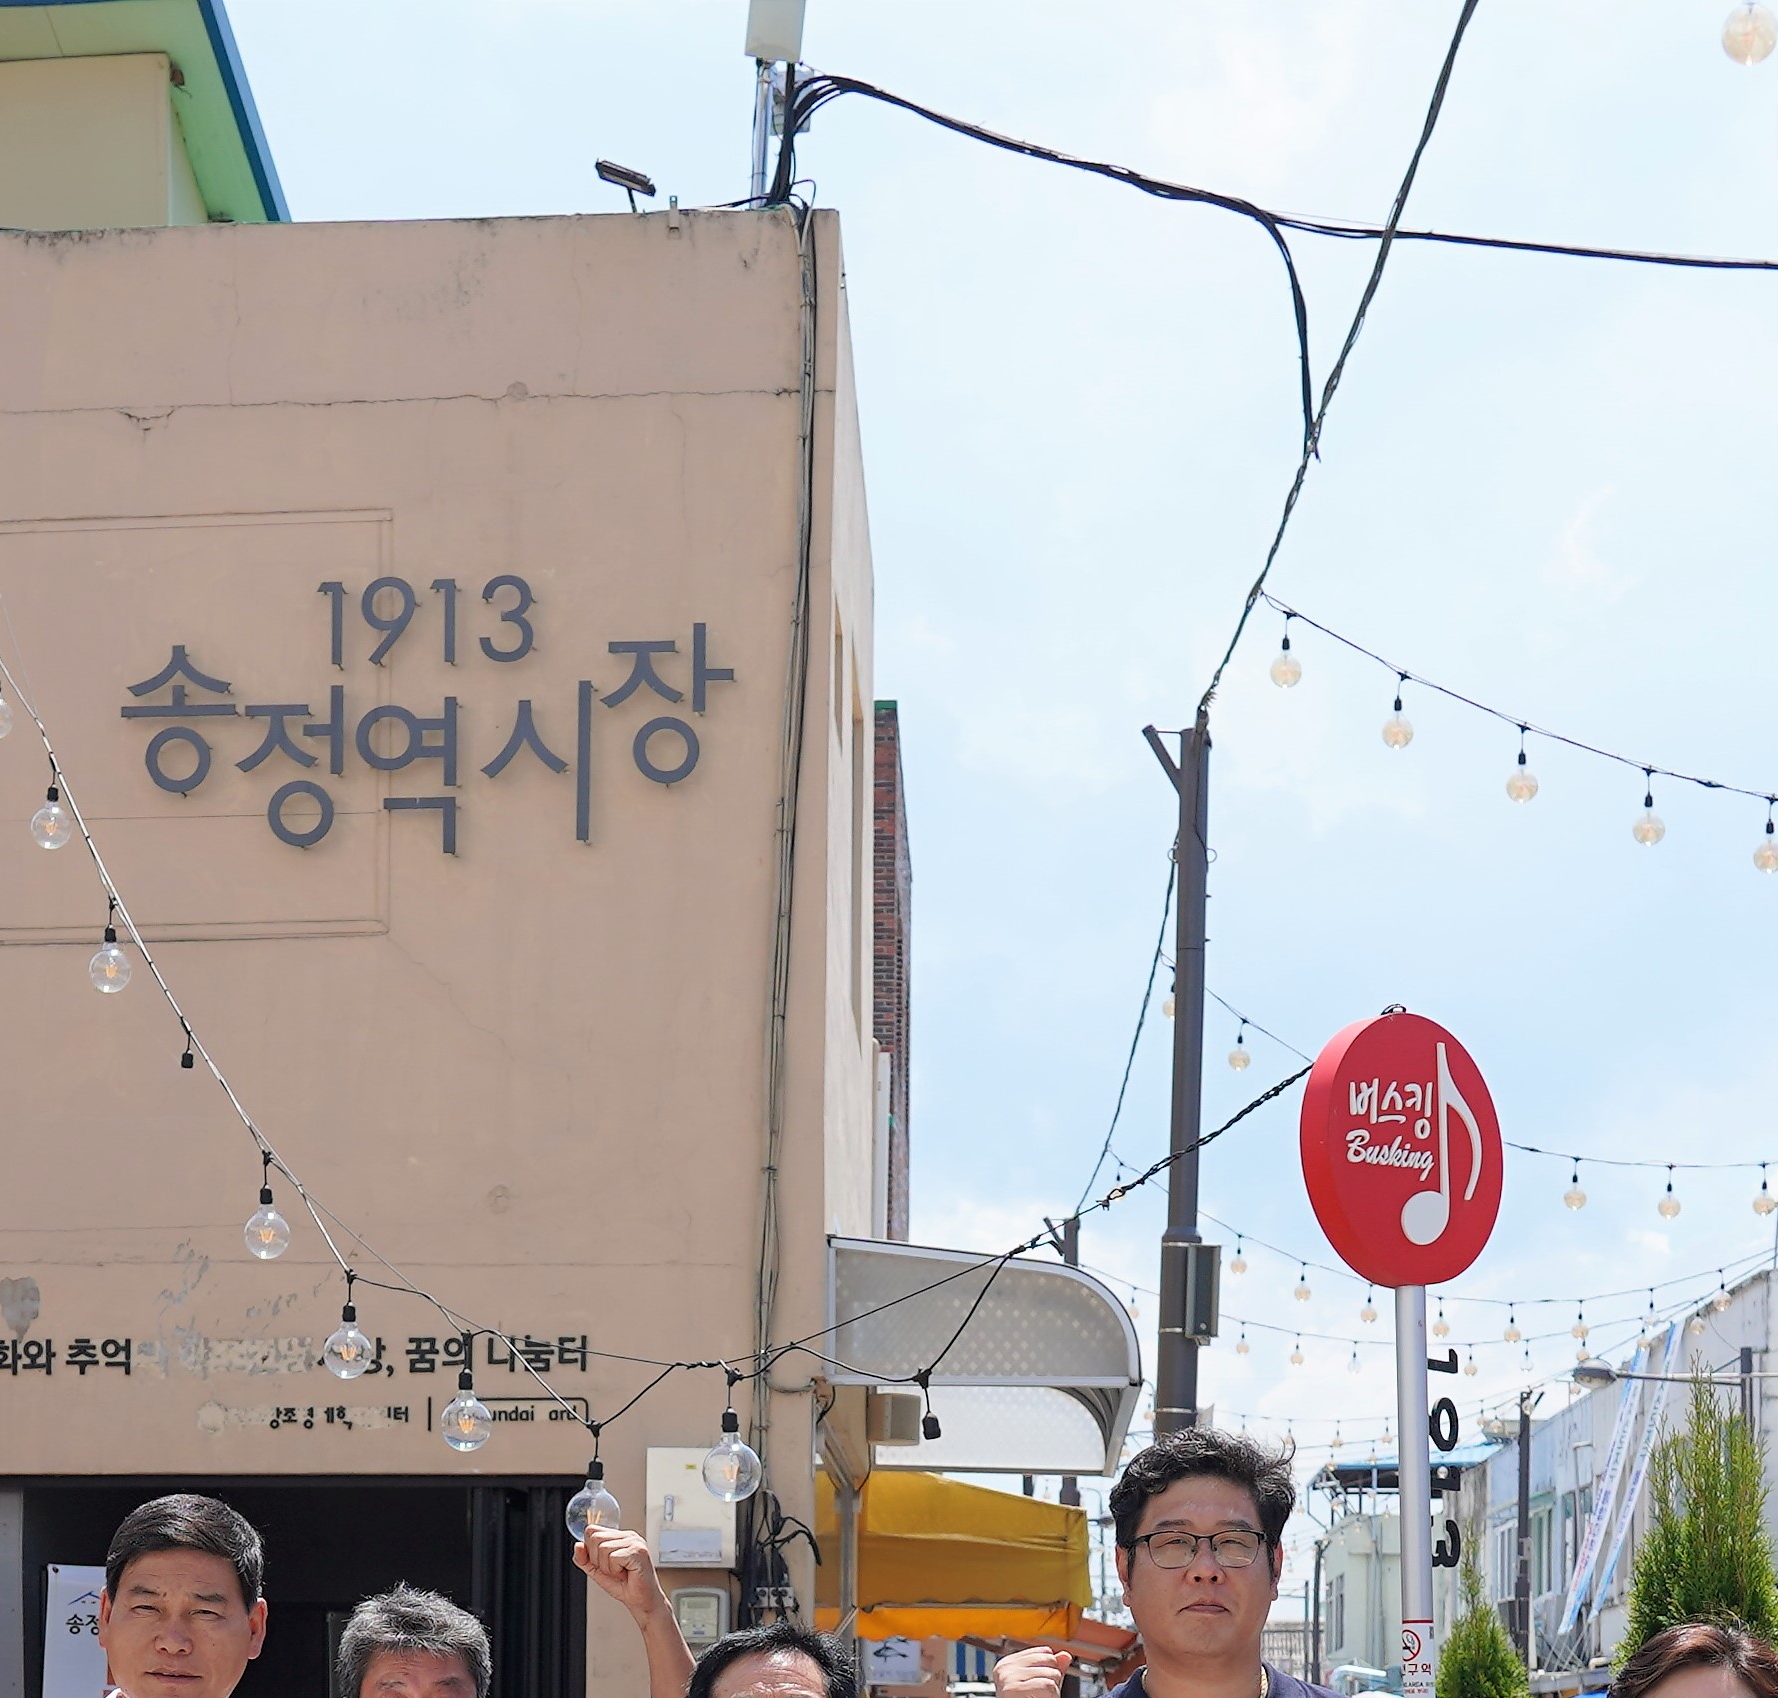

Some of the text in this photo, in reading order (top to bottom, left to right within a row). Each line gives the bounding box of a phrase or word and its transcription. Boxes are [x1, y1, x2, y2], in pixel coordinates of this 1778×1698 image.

[317, 575, 536, 666] 1913
[119, 622, 734, 855] 송정역시장
[1349, 1078, 1433, 1139] 버스킹
[1345, 1129, 1434, 1181] Busking
[405, 1336, 473, 1373] 꿈의
[487, 1335, 589, 1373] 나눔터
